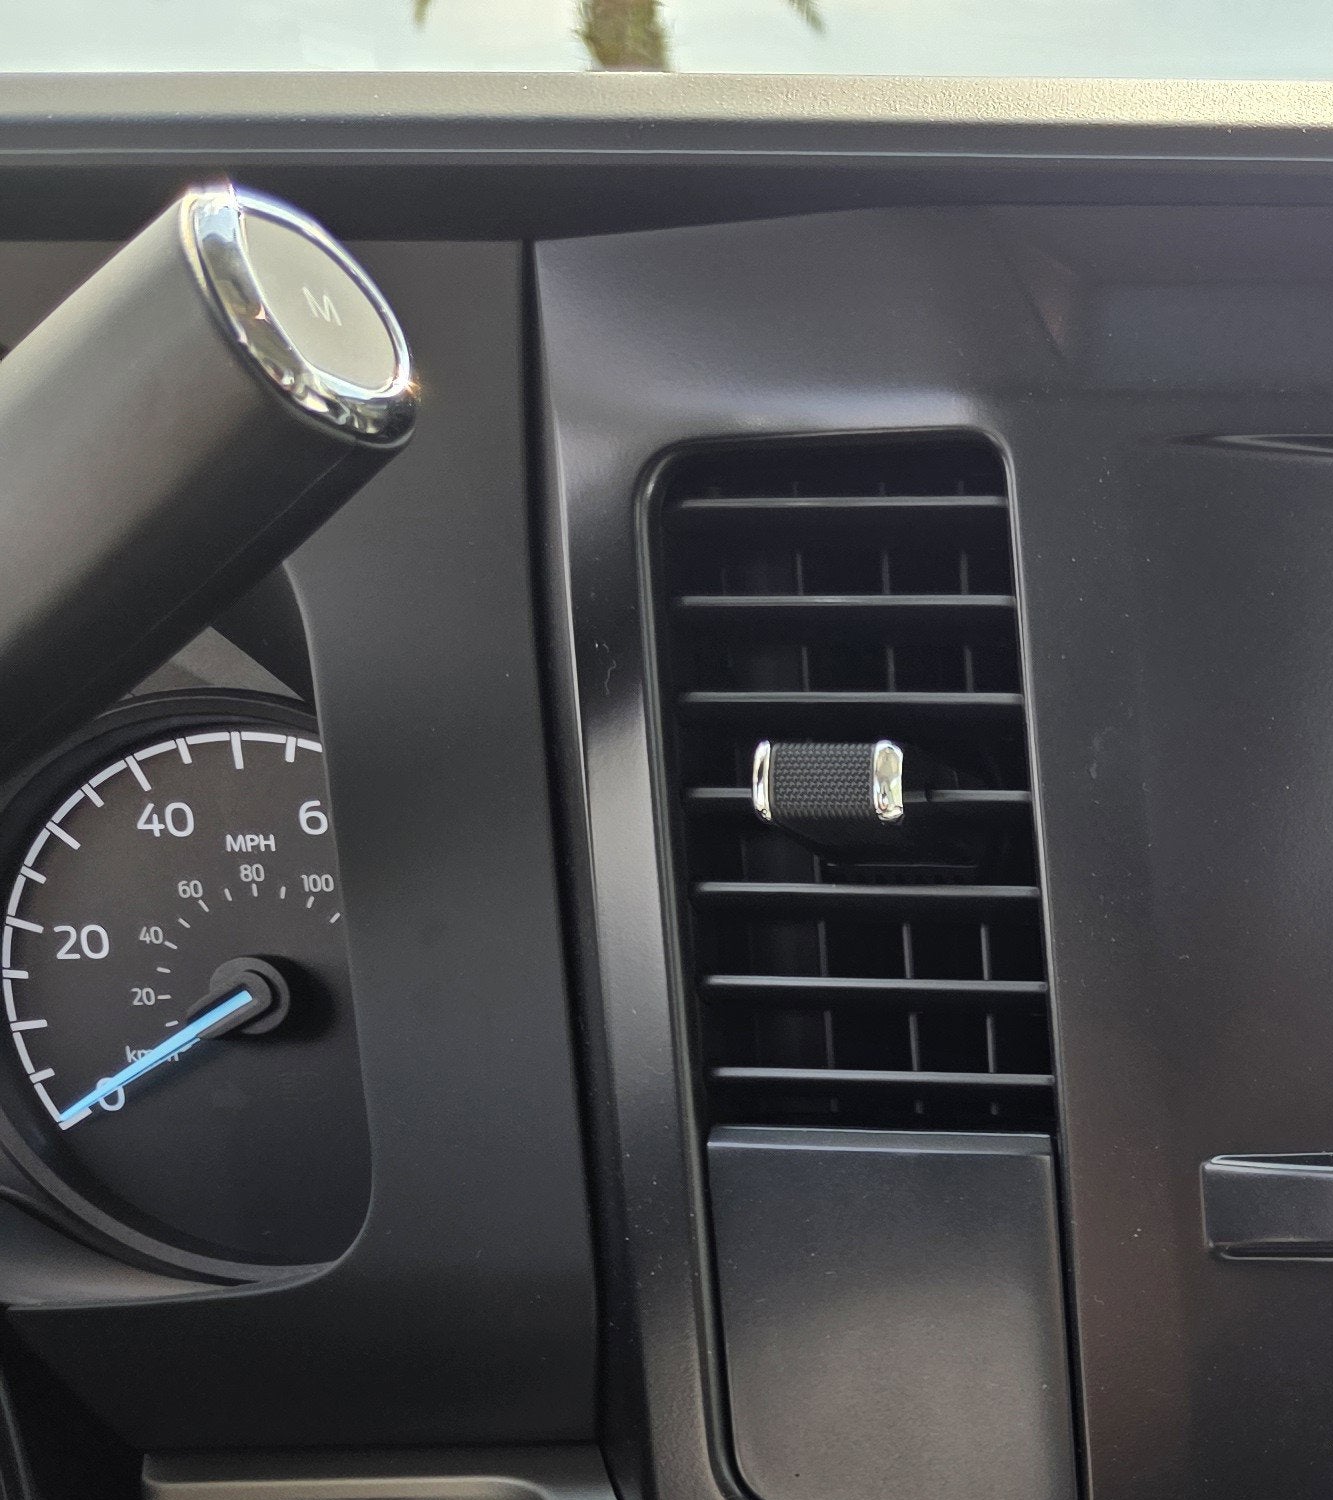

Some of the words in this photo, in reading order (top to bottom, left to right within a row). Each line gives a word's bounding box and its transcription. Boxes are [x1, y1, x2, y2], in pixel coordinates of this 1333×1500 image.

[137, 802, 194, 837] 40
[225, 834, 276, 852] MPH
[239, 864, 265, 882] 80
[177, 880, 203, 898] 60
[300, 874, 334, 892] 100
[54, 924, 110, 960] 20
[139, 926, 164, 944] 40
[132, 988, 155, 1006] 20
